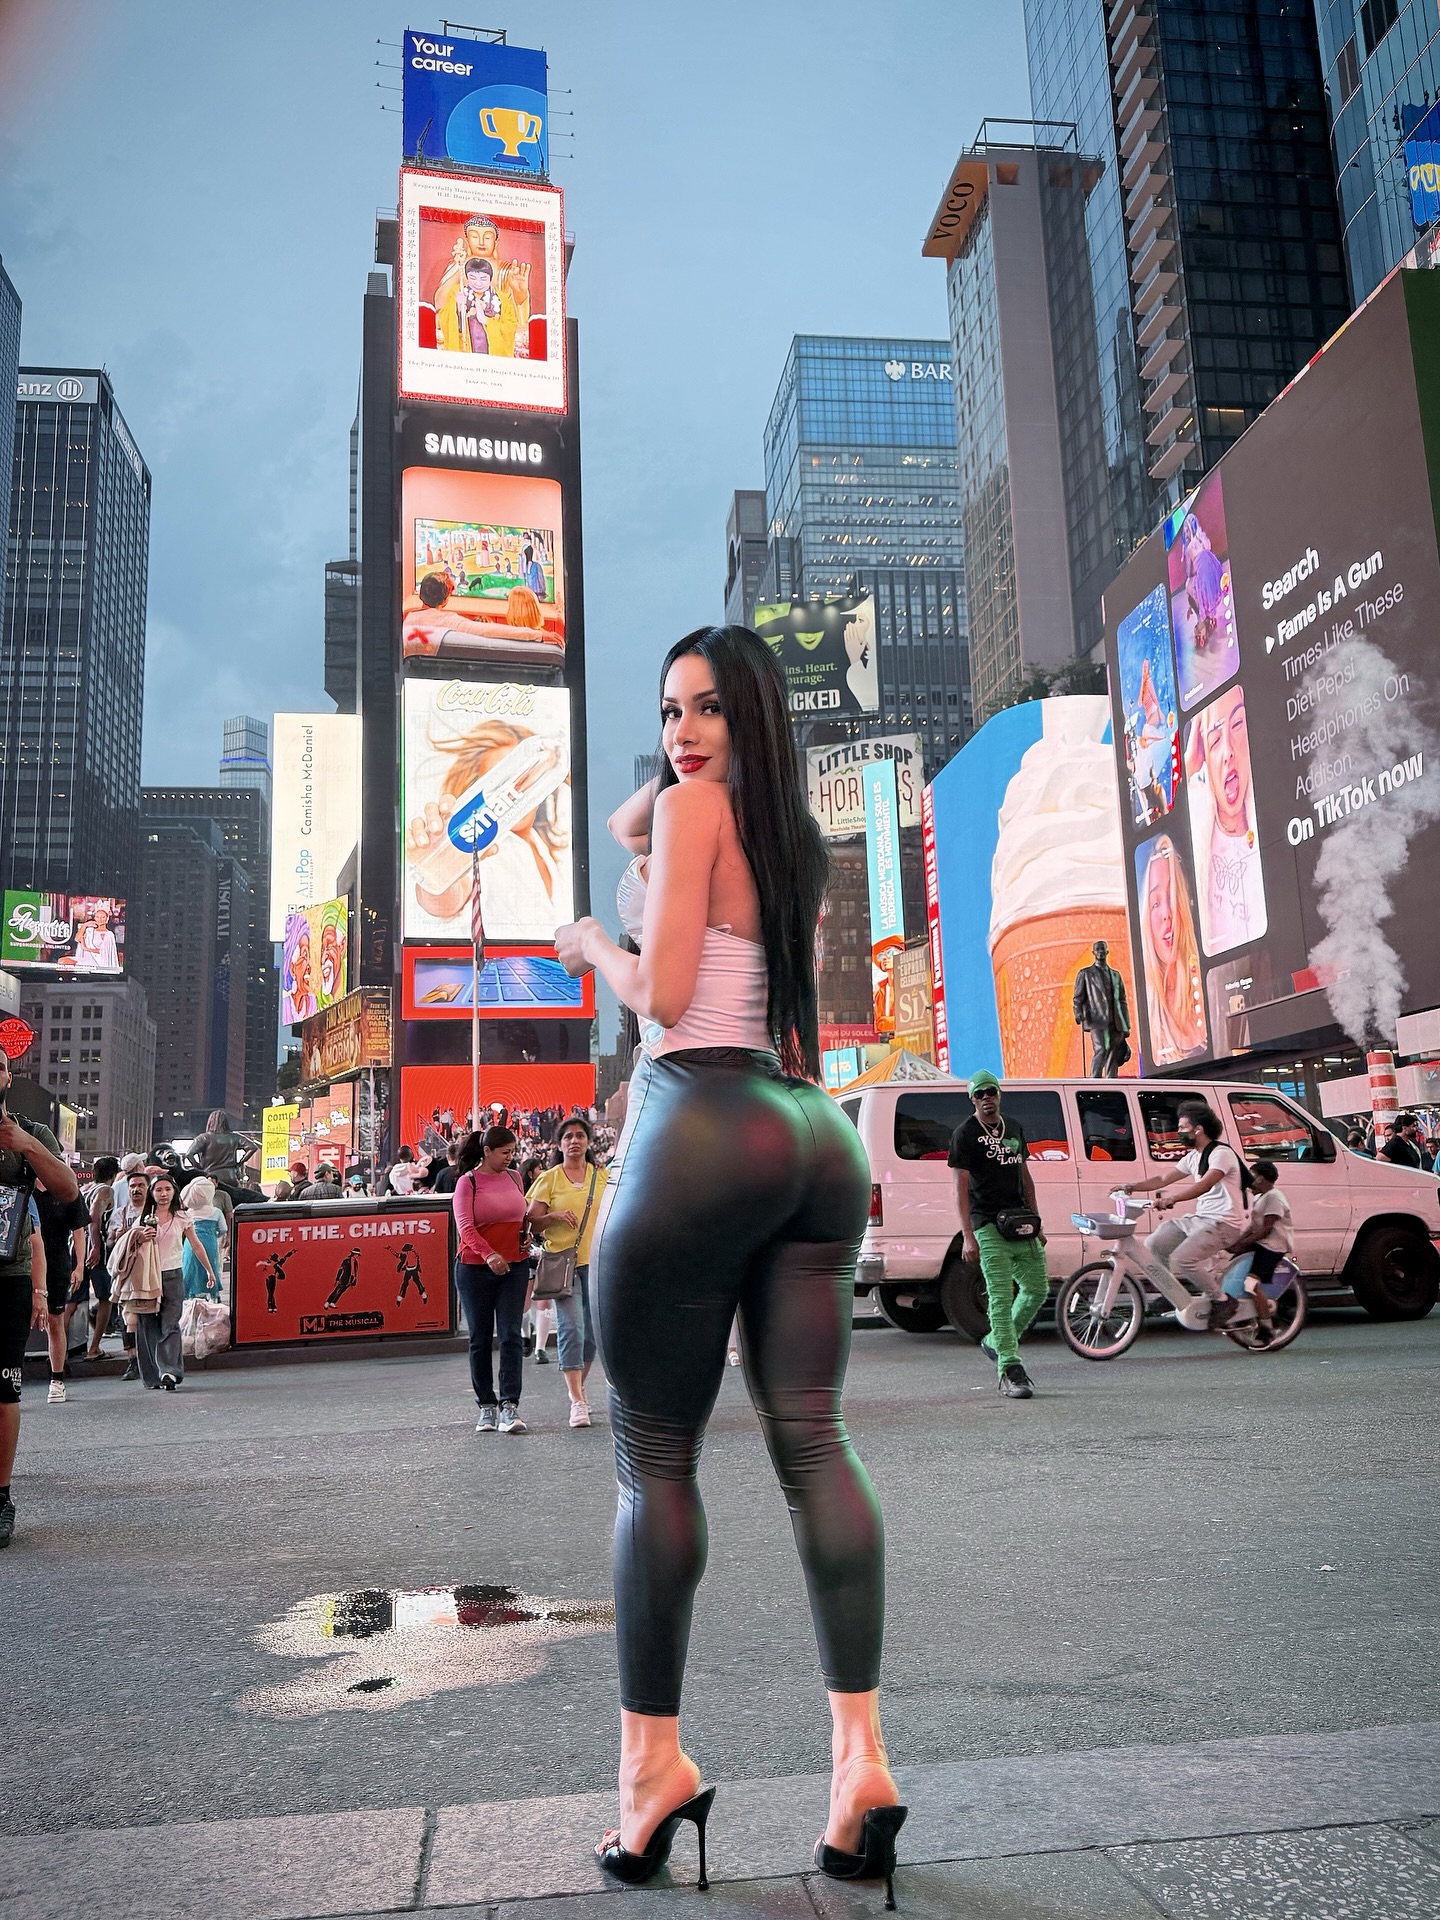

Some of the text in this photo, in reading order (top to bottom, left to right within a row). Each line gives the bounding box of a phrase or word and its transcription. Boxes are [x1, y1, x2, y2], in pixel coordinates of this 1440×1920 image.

[412, 37, 454, 57] Your
[412, 56, 473, 76] career
[424, 432, 543, 463] SAMSUNG
[1262, 547, 1320, 610] Search
[1277, 550, 1384, 646] Fame Is A Gun
[1282, 582, 1405, 682] Times Like These
[805, 662, 838, 673] Heart.
[436, 679, 539, 716] Coca-Cola
[1286, 656, 1355, 722] Diet Pepsi
[1290, 674, 1410, 762] Headphones On
[818, 743, 913, 777] LITTLE SHOP
[301, 725, 313, 835] Camisha McDaniel
[873, 781, 882, 793] ES
[1295, 753, 1352, 800] Addison
[873, 794, 883, 817] SOLO
[1287, 752, 1424, 846] On TikTok now
[875, 818, 884, 830] NO
[884, 857, 893, 869] ES
[926, 848, 939, 908] STORE
[935, 1000, 948, 1044] FREE
[267, 1111, 294, 1123] come
[977, 1135, 1001, 1146] You
[986, 1144, 1012, 1159] Are
[252, 1219, 436, 1244] OFF. THE. CHARTS.
[303, 1317, 326, 1333] MJ
[345, 1318, 379, 1326] MUSICAL
